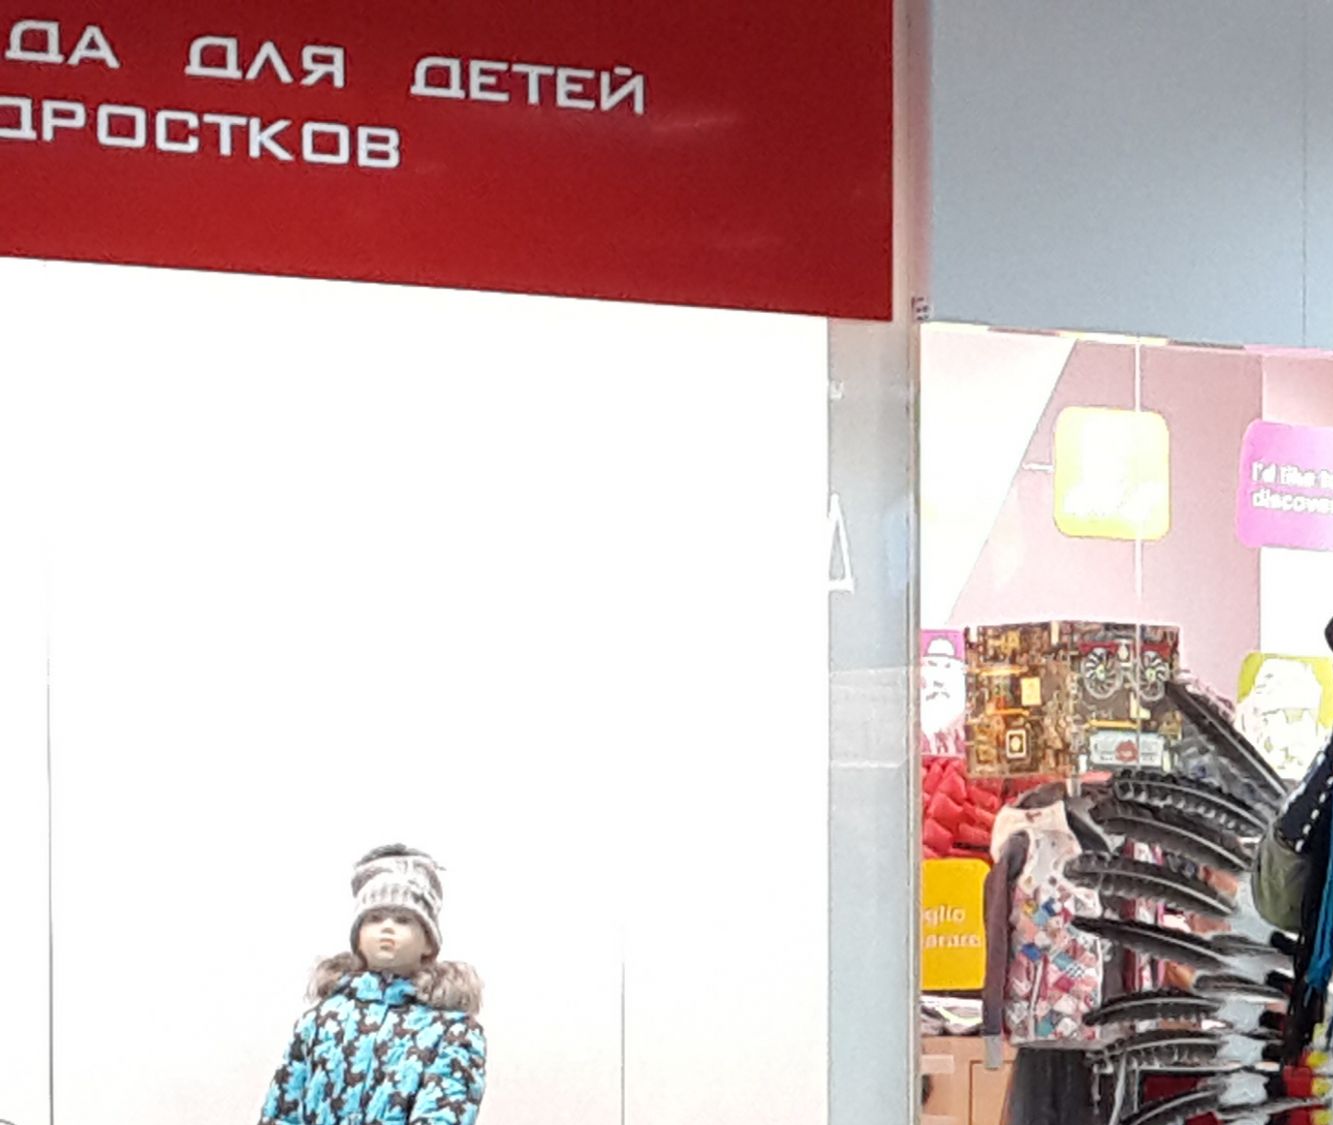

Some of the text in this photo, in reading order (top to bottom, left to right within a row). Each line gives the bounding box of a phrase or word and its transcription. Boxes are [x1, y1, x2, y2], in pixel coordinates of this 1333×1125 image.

[5, 19, 645, 115] ДА ДЛЯ ДЕТЕЙ
